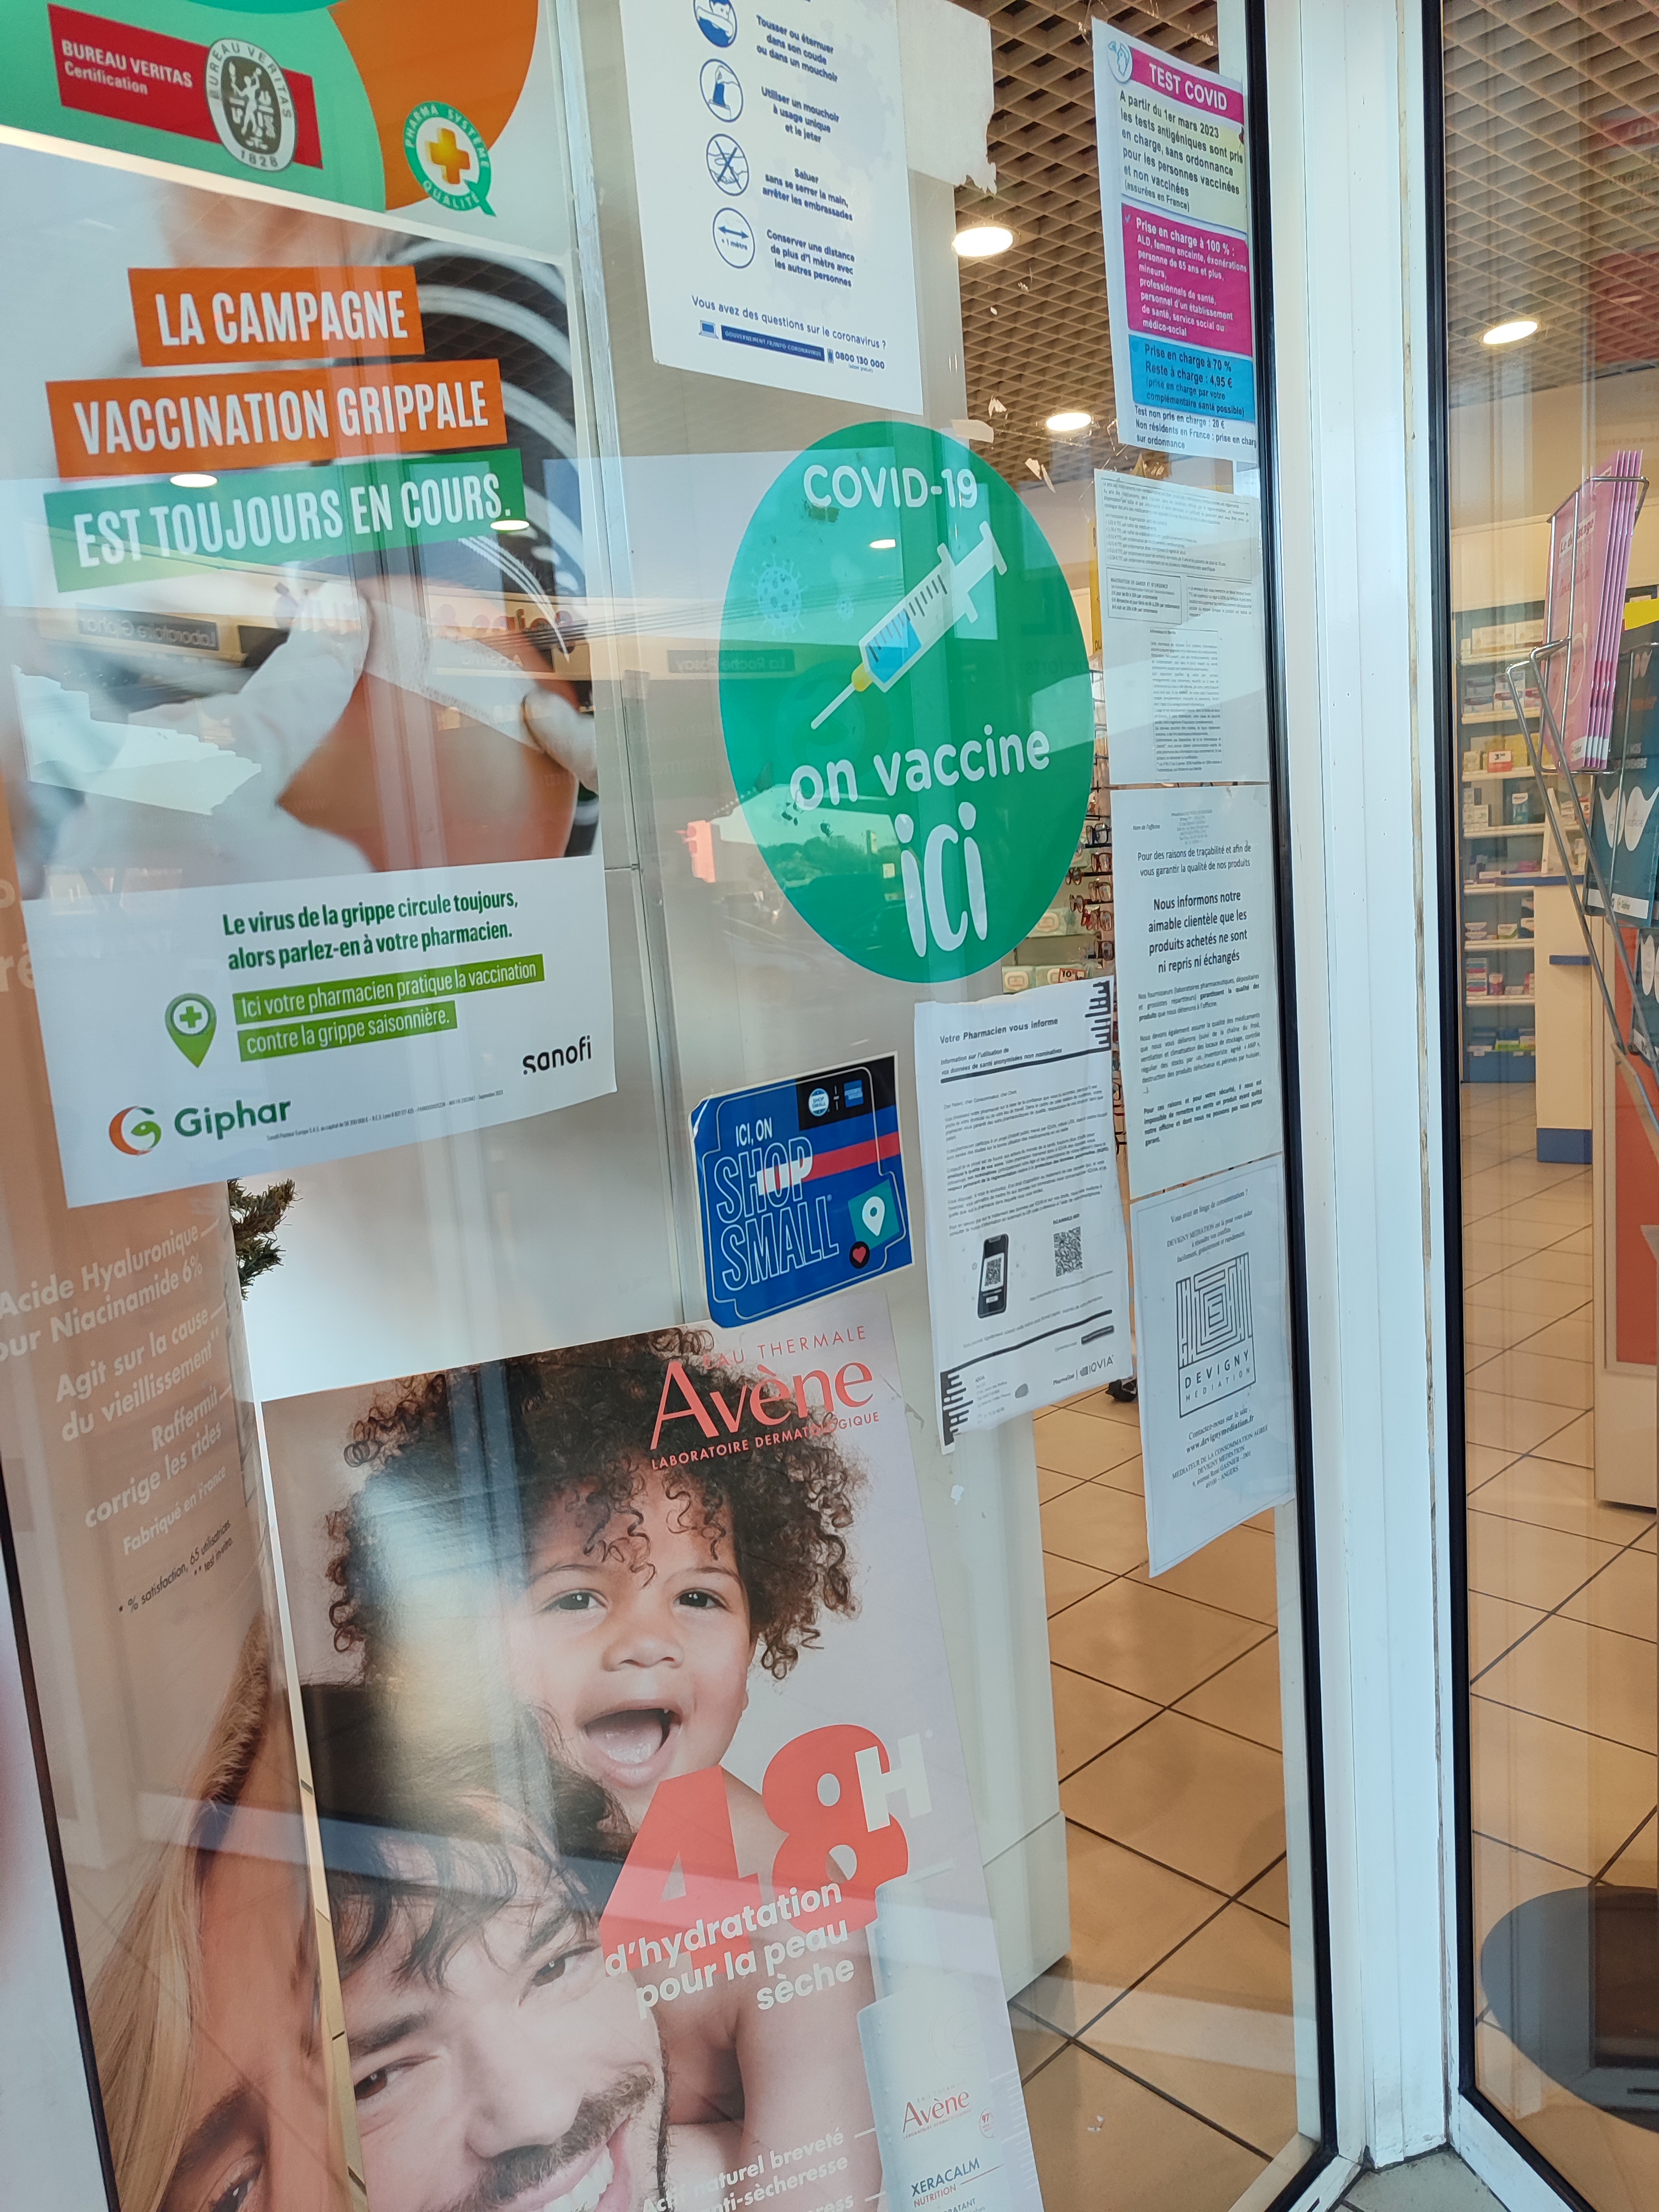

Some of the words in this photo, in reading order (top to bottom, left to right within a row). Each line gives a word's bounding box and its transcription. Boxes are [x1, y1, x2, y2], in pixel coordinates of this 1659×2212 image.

[62, 39, 128, 71] BUREAU
[129, 57, 194, 88] VERITAS
[64, 61, 149, 95] Certification
[208, 42, 240, 99] BUREAU
[247, 46, 291, 118] VERITAS
[1149, 63, 1181, 95] TEST
[1185, 81, 1228, 111] COVID
[405, 105, 439, 148] PHARMA
[1121, 108, 1133, 123] les
[1135, 114, 1155, 132] tests
[1157, 125, 1207, 152] antigéniques
[1209, 145, 1227, 158] sont
[1229, 148, 1243, 164] pris
[1128, 94, 1150, 112] partir
[1152, 103, 1162, 118] du
[1164, 109, 1175, 123] 1er
[1178, 116, 1197, 132] mars
[1200, 122, 1219, 139] 2023
[241, 150, 278, 167] 1828
[1121, 128, 1131, 140] en
[1134, 132, 1164, 155] charge,
[1166, 147, 1183, 161] sans
[1186, 153, 1233, 176] ordonnance
[155, 294, 205, 346] LA
[212, 290, 408, 345] CAMPAGNE
[692, 295, 716, 311] Vous
[719, 303, 739, 316] avez
[743, 307, 758, 321] des
[761, 312, 804, 331] questions
[807, 324, 820, 336] sur
[822, 325, 831, 337] le
[832, 328, 880, 349] coronavirus
[856, 354, 868, 367] 130
[870, 357, 885, 369] 000
[1145, 344, 1165, 357] Prise
[1167, 349, 1177, 360] en
[1179, 352, 1204, 368] charge
[1207, 358, 1211, 369] à
[1213, 358, 1222, 371] 70
[1224, 360, 1232, 373] %
[74, 389, 329, 455] VACCINATION
[338, 380, 489, 437] GRIPPALE
[804, 465, 978, 508] COVID-19
[73, 508, 144, 568] EST
[150, 489, 343, 558] TOUJOURS
[352, 484, 393, 535] EN
[401, 473, 512, 528] COURS.
[790, 759, 858, 810] on
[873, 724, 1050, 796] vaccine
[1138, 852, 1152, 862] Pour
[1154, 851, 1165, 859] des
[1166, 849, 1187, 859] raisons
[1188, 847, 1195, 857] de
[1197, 845, 1225, 858] traçabilité
[1226, 846, 1232, 854] et
[1233, 843, 1243, 853] afin
[1244, 842, 1251, 852] de
[1140, 867, 1155, 877] vous
[1156, 863, 1179, 878] garantir
[1181, 864, 1186, 873] la
[1187, 860, 1207, 874] qualité
[1208, 861, 1216, 870] de
[1217, 861, 1227, 869] nos
[1228, 858, 1250, 871] produits
[223, 915, 245, 936] Le
[249, 911, 295, 931] virus
[299, 906, 320, 927] de
[322, 904, 338, 926] la
[342, 901, 395, 927] grippe
[398, 894, 451, 917] circule
[453, 891, 518, 912] toujours,
[1148, 917, 1182, 933] aimable
[1183, 912, 1218, 928] clientèle
[1220, 913, 1235, 926] que
[1236, 909, 1247, 920] les
[1153, 897, 1175, 911] Nous
[1177, 893, 1218, 908] informons
[1220, 890, 1241, 904] notre
[228, 947, 275, 970] alors
[279, 939, 360, 969] parlez-en
[364, 934, 373, 955] à
[376, 931, 418, 953] votre
[421, 922, 513, 951] pharmacien.
[1149, 936, 1184, 957] produits
[1186, 932, 1217, 948] achetés
[1219, 931, 1229, 943] ne
[1230, 929, 1248, 941] sont
[1157, 962, 1166, 974] ni
[1168, 957, 1192, 973] repris
[1194, 954, 1202, 968] ni
[1203, 948, 1240, 968] échangés
[242, 996, 262, 1018] Ici
[264, 996, 305, 1016] votre
[309, 983, 394, 1013] pharmacien
[398, 974, 452, 1000] pratique
[455, 968, 467, 989] la
[468, 962, 536, 986] vaccination
[247, 1030, 298, 1054] contre
[301, 1029, 315, 1045] la
[319, 1020, 365, 1046] grippe
[368, 1009, 451, 1036] saisonnière.
[940, 1034, 960, 1044] Votre
[963, 1026, 1007, 1041] Pharmacien
[1009, 1022, 1029, 1032] vous
[1031, 1017, 1058, 1029] informe
[522, 1035, 592, 1076] sanofi
[175, 1100, 291, 1140] Giphar
[735, 1122, 754, 1147] ICI,
[756, 1117, 773, 1141] ON
[714, 1136, 813, 1224] SHOP
[721, 1195, 839, 1292] SMALL
[0, 1274, 74, 1318] Acide
[81, 1223, 199, 1292] Hyaluronique
[50, 1270, 179, 1343] Niacinamide
[182, 1253, 203, 1282] 6%
[56, 1360, 107, 1403] Agit
[114, 1347, 144, 1376] sur
[149, 1331, 167, 1357] la
[171, 1307, 208, 1345] cause
[703, 1348, 745, 1370] EAU
[757, 1326, 867, 1359] THERMALE
[1185, 1349, 1249, 1389] DEVIGNY
[650, 1361, 874, 1451] Avène
[1186, 1367, 1250, 1402] MEDIATION
[61, 1410, 94, 1441] du
[151, 1385, 218, 1451] Raffermit
[651, 1439, 749, 1470] LABORATOIRE
[755, 1411, 879, 1449] DERMATOLOGIQUE
[1186, 1413, 1254, 1454] www.devignymediation.fr
[85, 1471, 160, 1527] corrige
[165, 1454, 187, 1480] les
[191, 1418, 222, 1462] rides
[123, 1502, 181, 1556] Fabriqué
[184, 1494, 196, 1511] en
[199, 1466, 226, 1500] France
[605, 1881, 842, 1978] d'hydratation
[637, 1961, 717, 2021] pour
[724, 1948, 757, 1981] la
[765, 1919, 848, 1978] peau
[757, 1959, 854, 2011] sèche
[902, 2091, 970, 2133] Avène
[770, 2127, 844, 2169] breveté
[911, 2157, 980, 2197] XERACALM
[914, 2184, 957, 2208] NUTRITION
